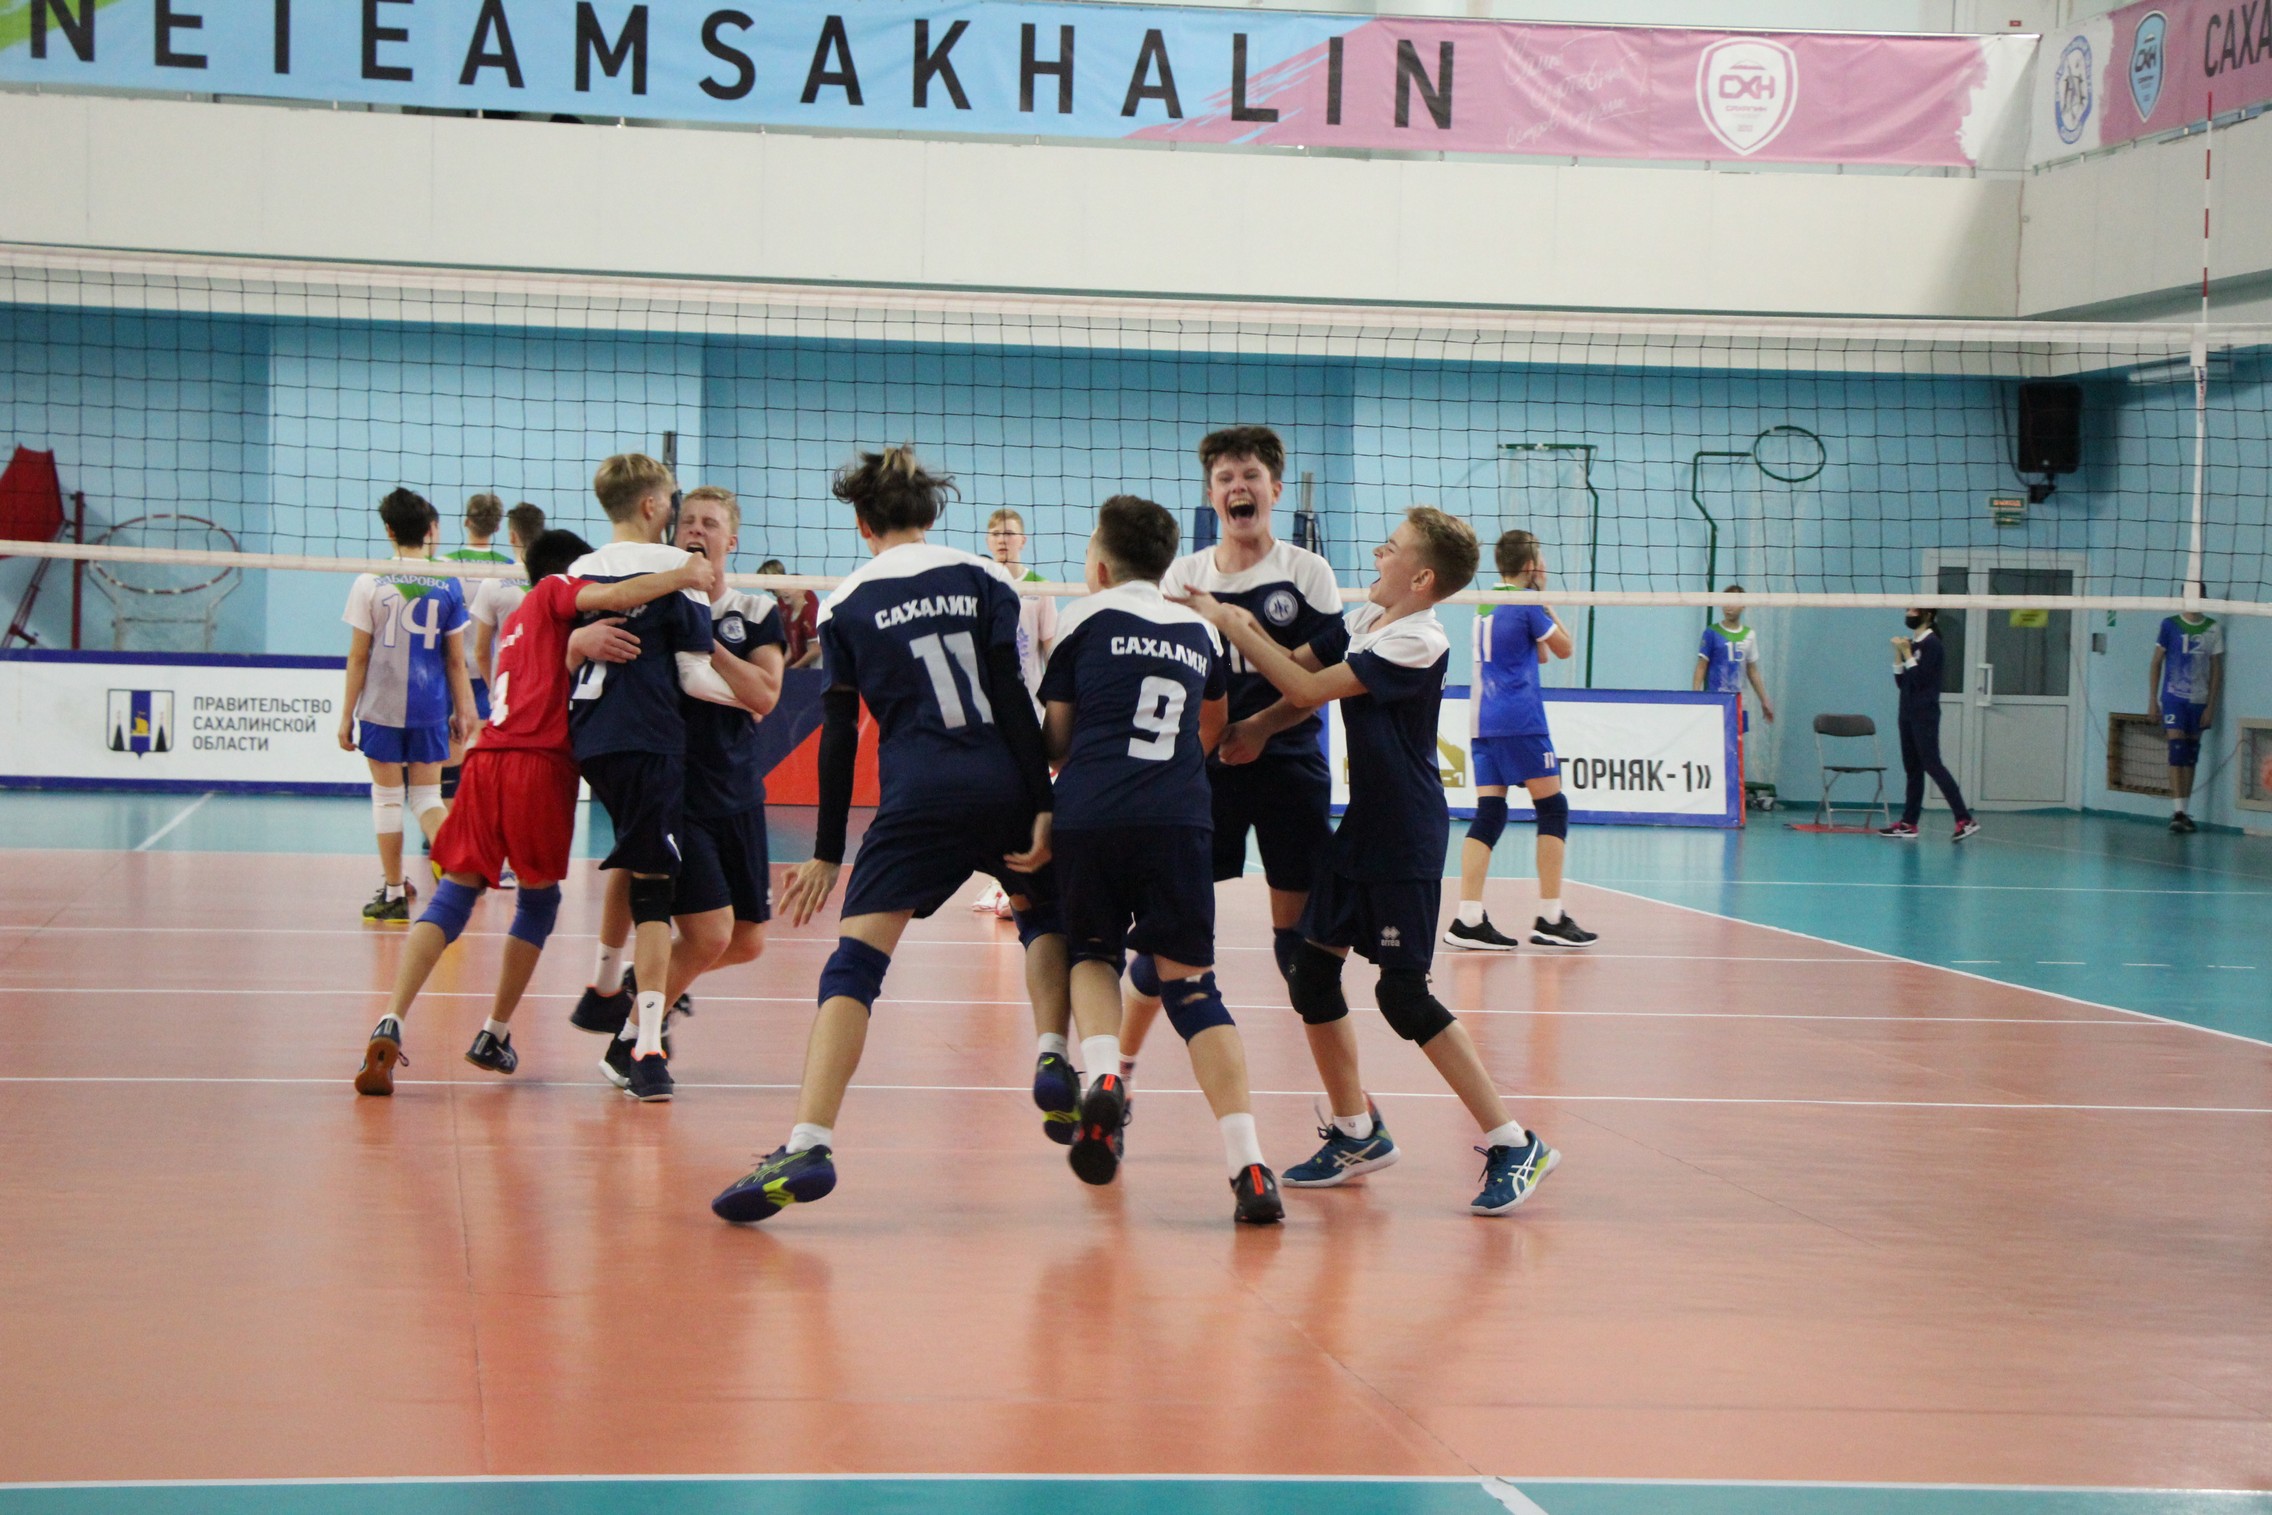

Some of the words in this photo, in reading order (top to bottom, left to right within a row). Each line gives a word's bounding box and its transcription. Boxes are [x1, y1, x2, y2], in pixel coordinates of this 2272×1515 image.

[382, 593, 440, 650] 14
[874, 595, 979, 630] САХАЛИН
[1472, 613, 1495, 663] 11
[1724, 641, 1746, 662] 15
[2181, 633, 2206, 654] 12
[1110, 636, 1208, 677] САХАЛИН
[908, 630, 995, 730] 11
[193, 696, 332, 714] ПРАВИТЕЛЬСТВО
[1127, 675, 1187, 761] 9
[192, 715, 317, 733] САХАЛИНСКОЙ
[192, 735, 269, 751] ОБЛАСТИ
[1543, 751, 1556, 769] 11
